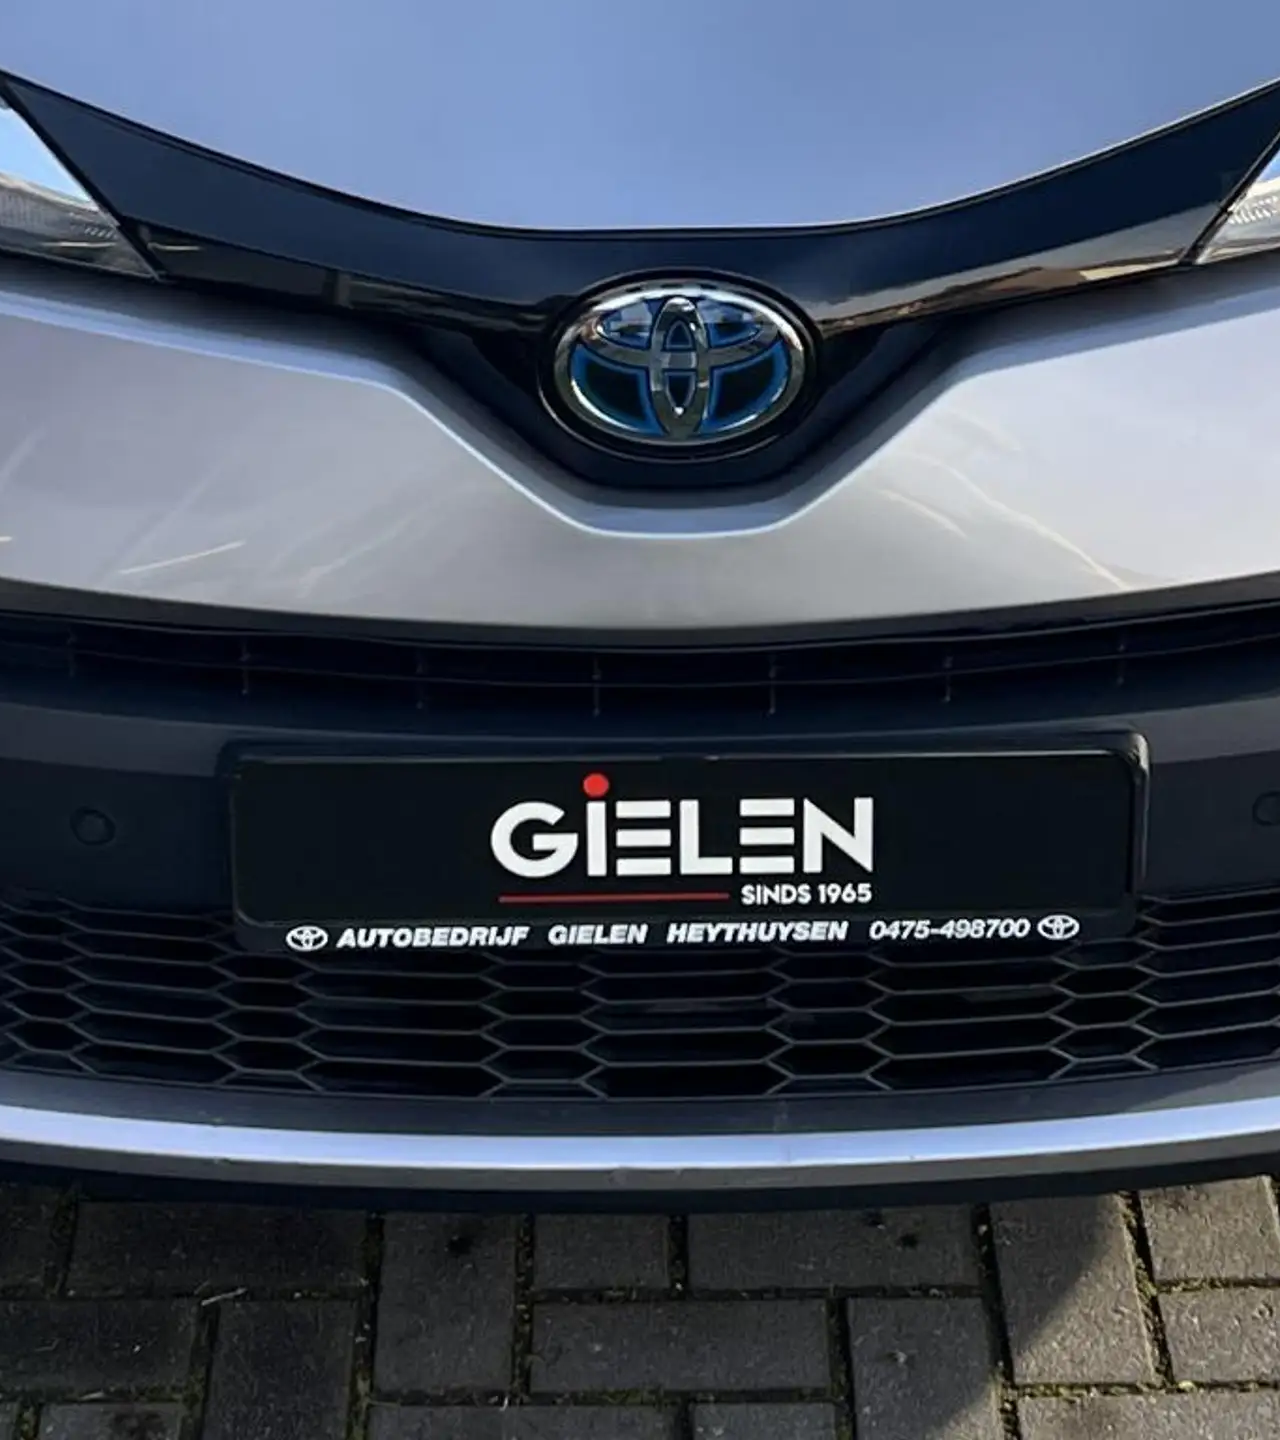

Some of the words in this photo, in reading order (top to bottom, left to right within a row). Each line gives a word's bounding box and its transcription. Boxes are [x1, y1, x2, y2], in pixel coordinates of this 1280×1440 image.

[740, 883, 812, 906] SINDS
[817, 881, 873, 904] 1965
[336, 925, 531, 949] AUTOBEDRIJF
[547, 923, 649, 946] GIELEN
[666, 920, 849, 944] HEYTHUYSEN
[868, 917, 1031, 941] 0475-498700
